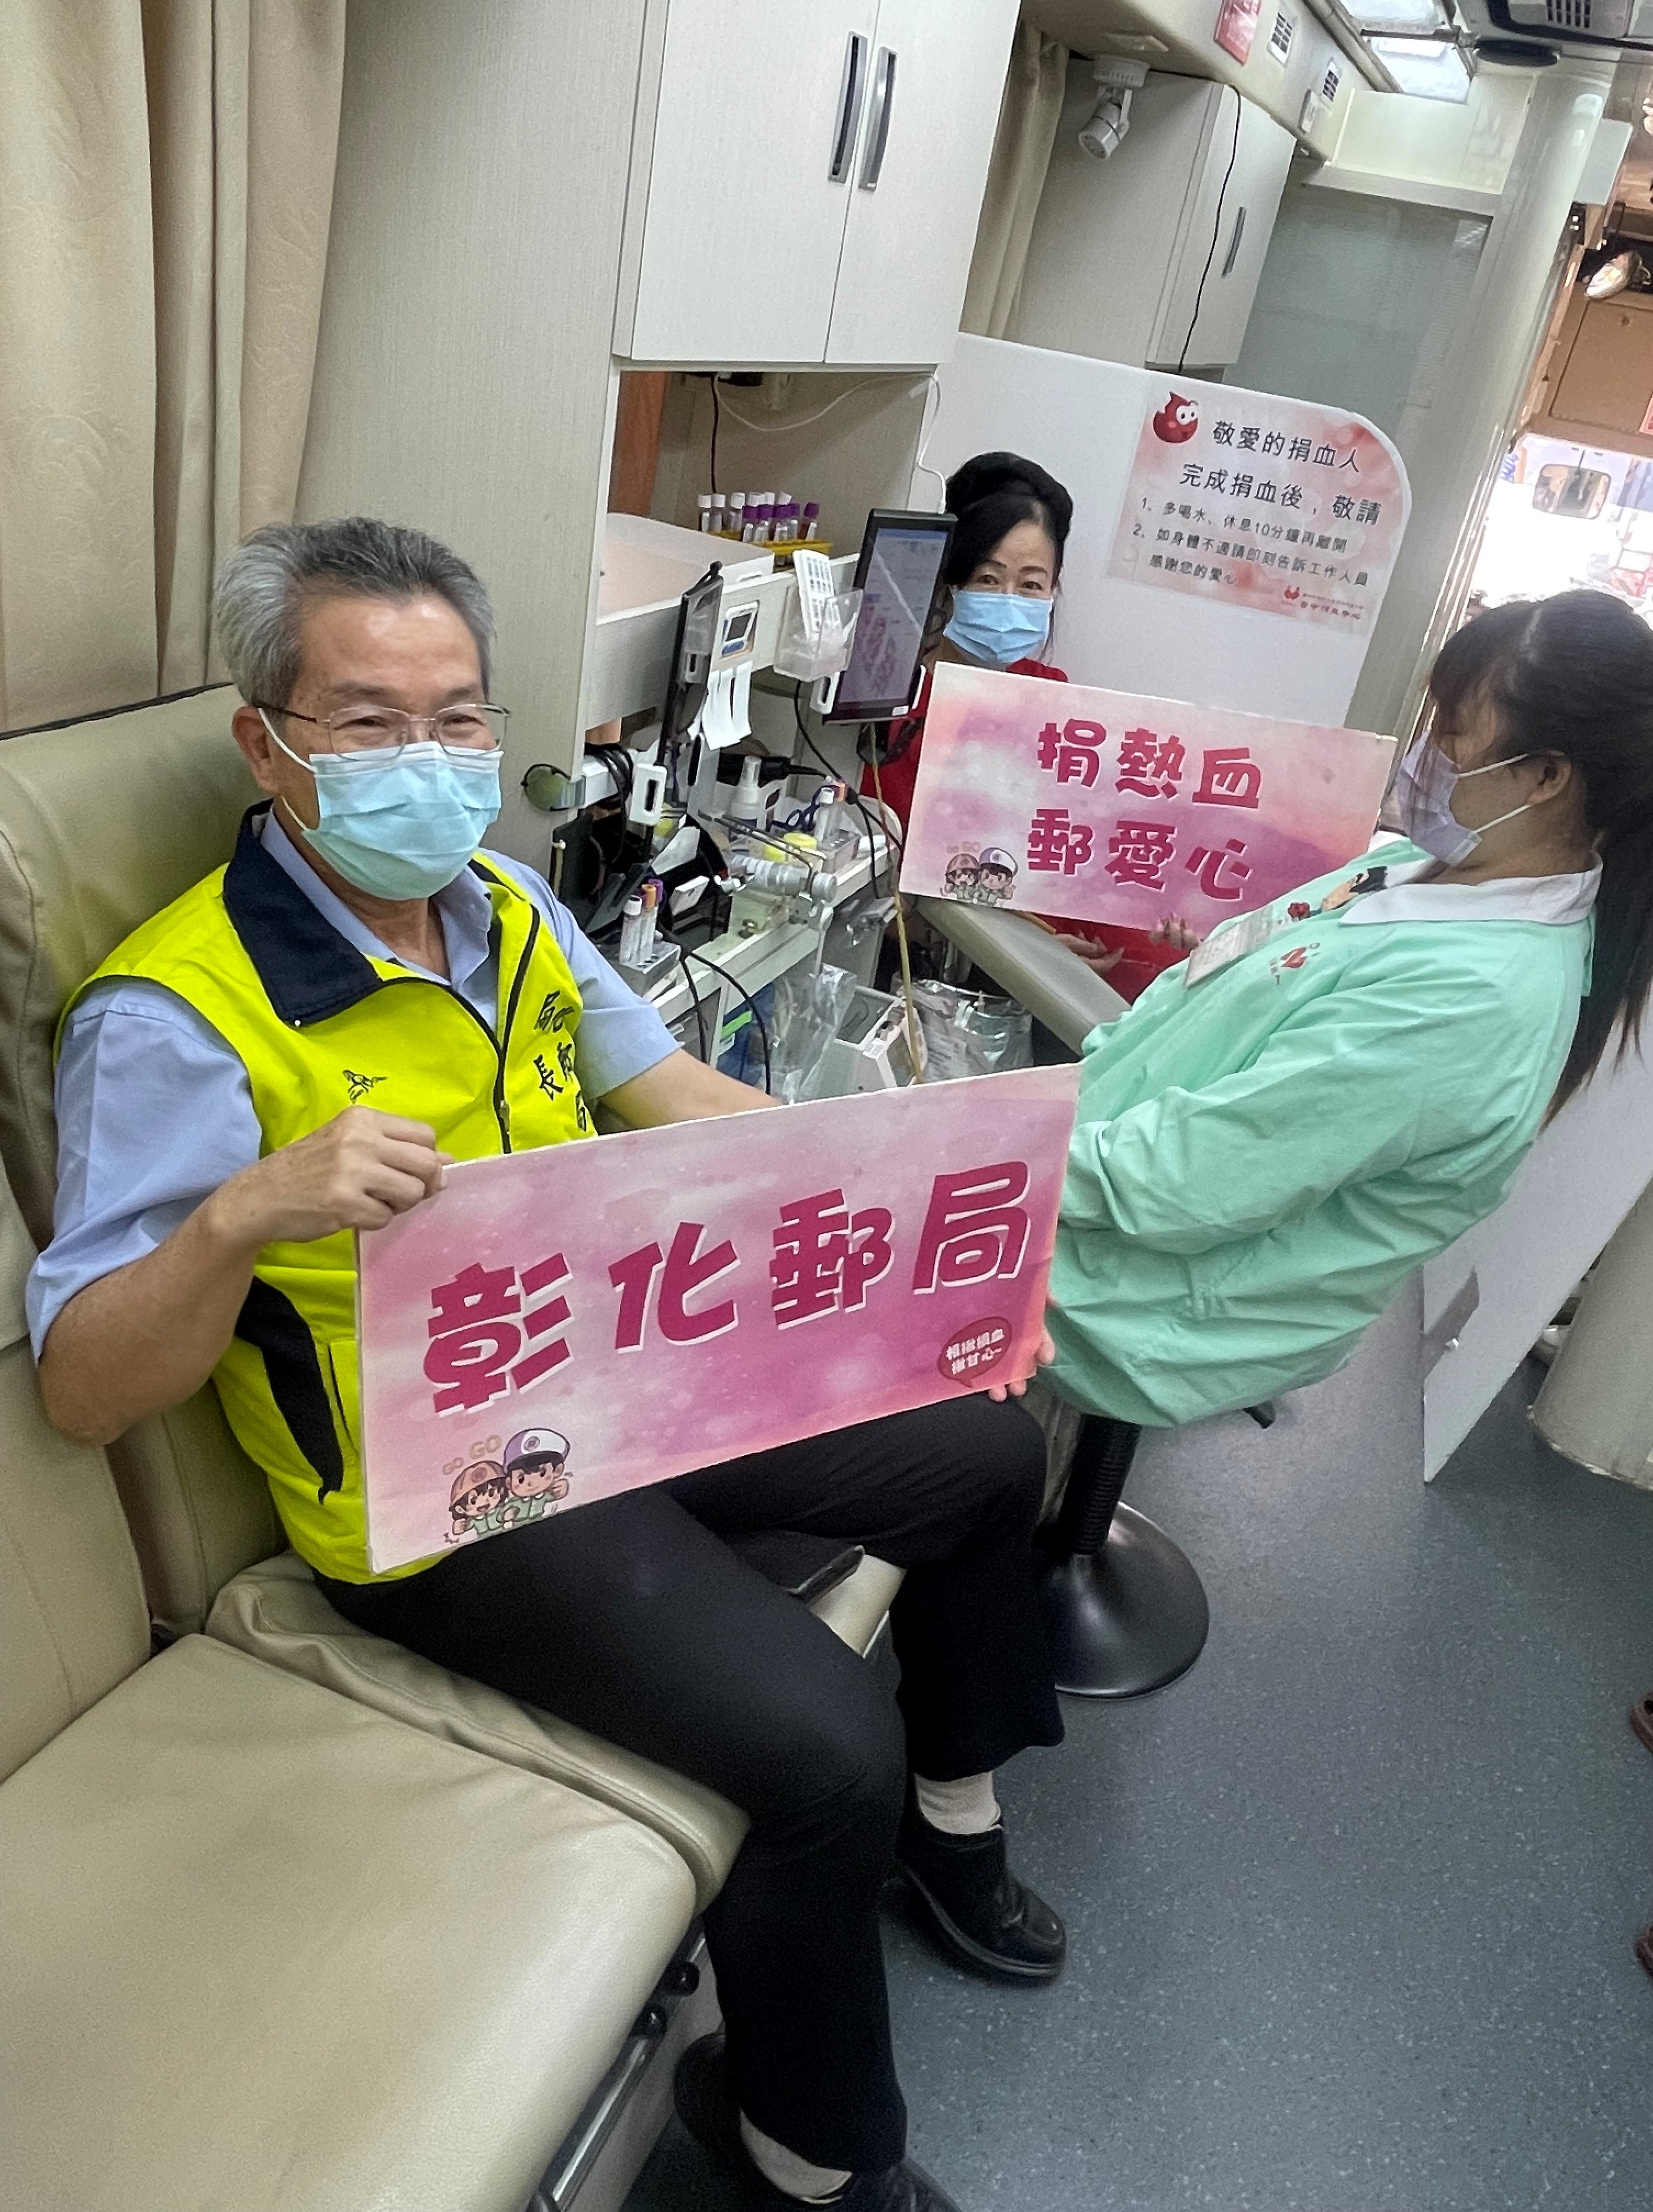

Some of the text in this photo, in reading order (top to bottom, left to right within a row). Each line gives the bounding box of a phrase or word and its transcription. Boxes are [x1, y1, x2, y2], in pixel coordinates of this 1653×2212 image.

[1211, 420, 1360, 473] 敬愛的捐血人
[1149, 554, 1237, 586] 感謝您的愛心
[1037, 718, 1262, 810] 捐熱血
[1027, 809, 1253, 901] 郵愛心
[424, 1160, 1031, 1417] 彰化郵局
[469, 1435, 502, 1459] GO
